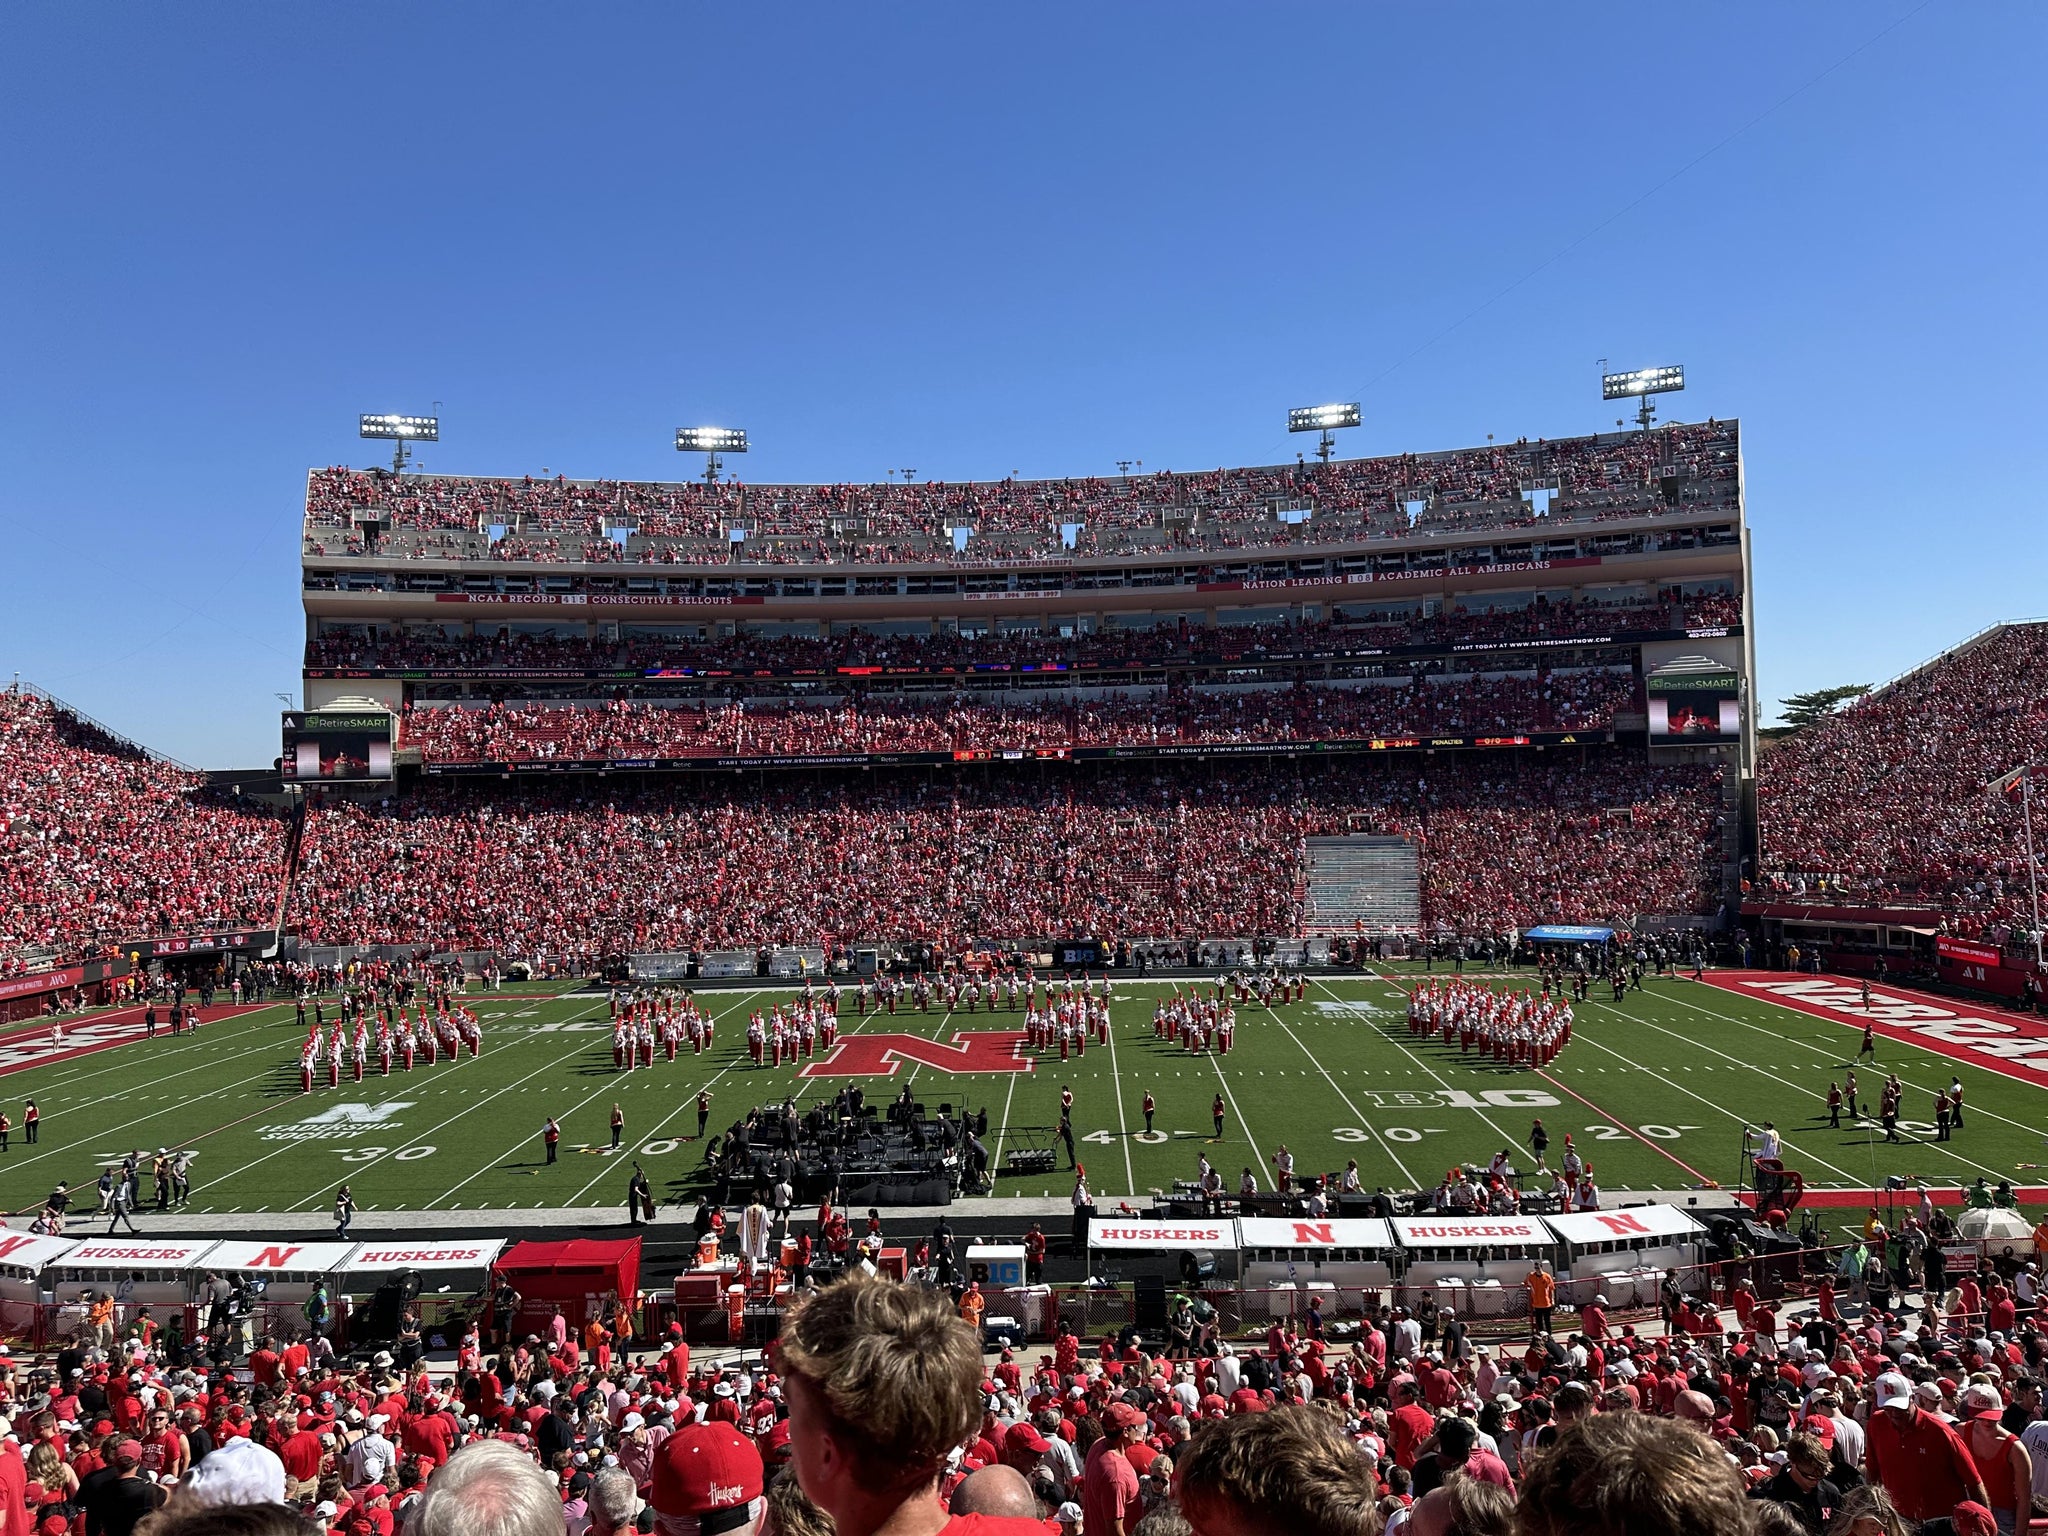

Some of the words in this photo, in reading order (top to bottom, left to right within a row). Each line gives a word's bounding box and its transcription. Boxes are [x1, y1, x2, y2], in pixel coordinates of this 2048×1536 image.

[1665, 467, 1675, 476] N
[1535, 480, 1544, 488] N
[1409, 491, 1419, 500] N
[1290, 501, 1299, 509] N
[367, 511, 378, 520] N
[494, 515, 505, 524] N
[1065, 514, 1074, 523] N
[1175, 509, 1184, 518] N
[617, 518, 627, 527] N
[733, 520, 744, 529] N
[846, 520, 856, 529] N
[957, 517, 967, 527] N
[948, 561, 995, 569] NATIONAL
[999, 559, 1073, 568] CHAMPIONSHIPS
[1242, 579, 1286, 590] NATION
[1292, 575, 1342, 587] LEADING
[1349, 573, 1372, 583] 108
[1378, 568, 1443, 581] ACADEMIC
[1448, 566, 1471, 577] ALL
[1477, 561, 1550, 574] AMERICANS
[468, 594, 503, 603] NCAA
[509, 595, 556, 603] RECORD
[562, 595, 586, 604] 415
[592, 596, 673, 605] CONSECUTIVE
[678, 596, 732, 605] SELLOUTS
[1509, 636, 1612, 648] WWW.RETIRESMARTNOW.COM
[1663, 678, 1735, 689] RetireSMART
[319, 718, 388, 728] RetireSMART
[1213, 744, 1310, 752] WWW.RETIRESMARTNOW.COM
[1372, 740, 1386, 749] N
[1432, 738, 1463, 746] PENALTIES
[159, 942, 170, 953] N
[175, 942, 185, 950] 10
[221, 938, 227, 946] 3
[1976, 966, 1985, 981] N
[49, 973, 67, 987] AVO
[794, 1031, 1036, 1079] N
[297, 1101, 418, 1124] N
[254, 1122, 404, 1133] LEADERSHIP
[1584, 1124, 1683, 1141] 20
[260, 1131, 367, 1140] SOCIETY
[1081, 1129, 1169, 1145] 40
[1331, 1127, 1423, 1143] 30
[342, 1146, 437, 1162] 30
[1596, 1213, 1652, 1235] N
[1100, 1228, 1220, 1241] HUSKERS
[1292, 1223, 1336, 1243] N
[1408, 1225, 1533, 1238] HUSKERS
[74, 1247, 192, 1259] HUSKERS
[245, 1246, 304, 1267] N
[358, 1249, 482, 1263] HUSKERS
[704, 1247, 712, 1255] G
[1820, 1330, 1826, 1346] 1
[1883, 1383, 1896, 1395] N
[757, 1413, 774, 1435] 93
[707, 1481, 744, 1506] Huskers
[1822, 1507, 1832, 1520] N
